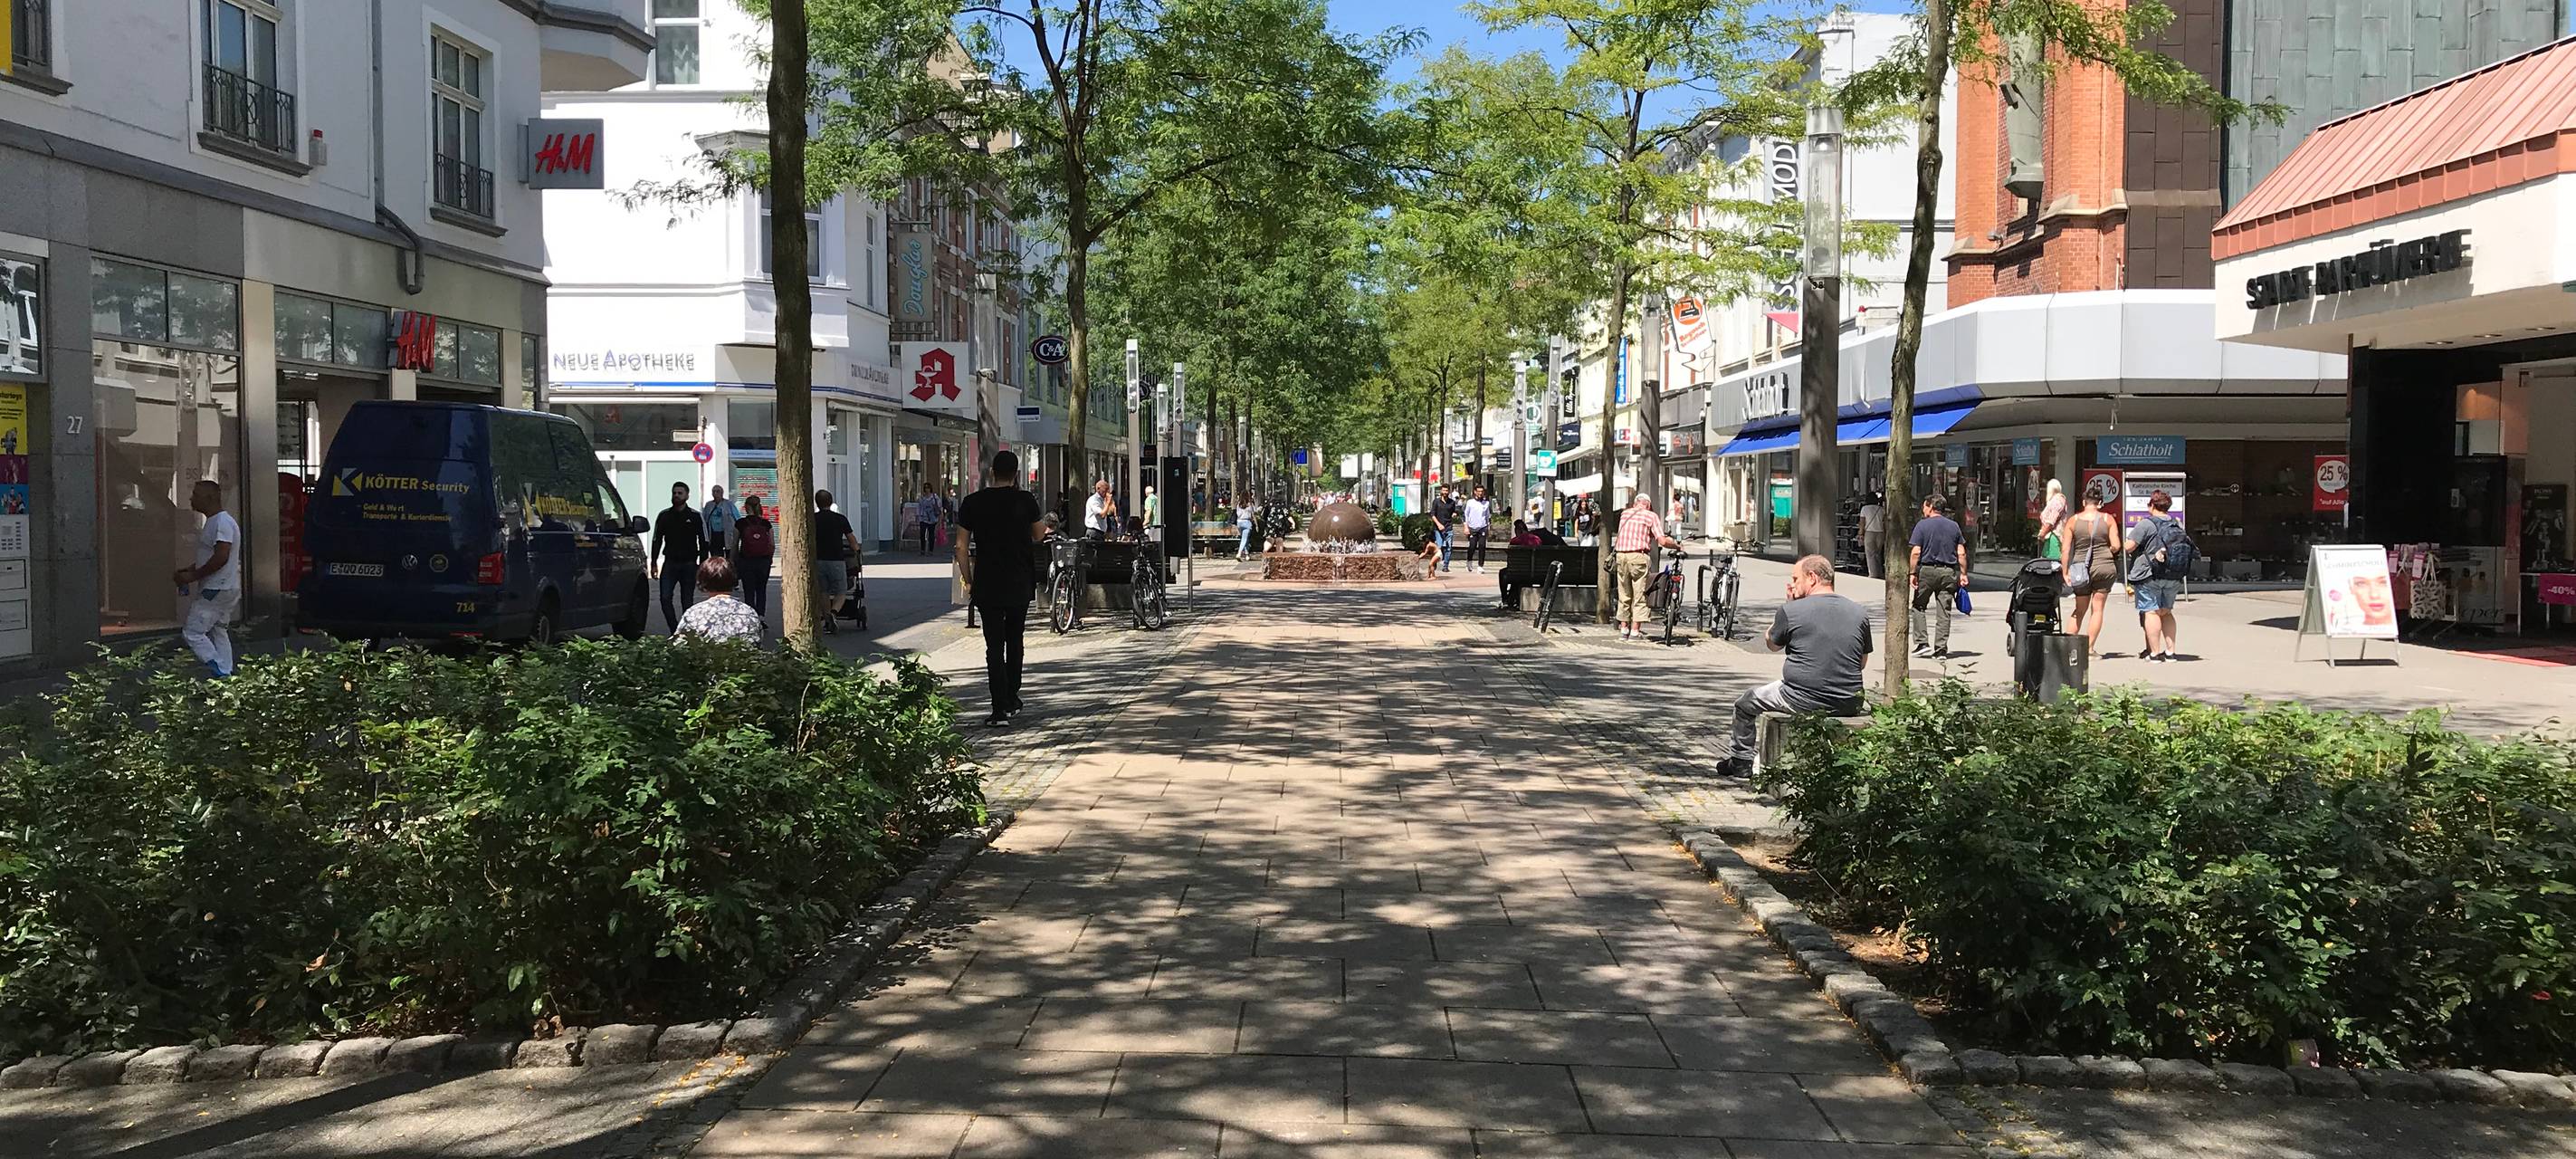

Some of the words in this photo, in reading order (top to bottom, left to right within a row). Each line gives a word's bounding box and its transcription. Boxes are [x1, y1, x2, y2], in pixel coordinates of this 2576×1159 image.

[535, 133, 595, 174] H&M
[902, 239, 928, 316] Douglas
[1813, 281, 1824, 290] 38
[396, 310, 435, 371] H&M
[1039, 342, 1065, 357] C&A
[553, 353, 599, 370] NEUE
[603, 350, 695, 371] APOTHEKE
[67, 416, 83, 434] 27
[2109, 442, 2174, 456] Schlatholt
[2321, 465, 2333, 481] 25
[2337, 465, 2349, 482] %
[366, 474, 418, 490] KÖTTER
[422, 481, 470, 494] Security
[2105, 479, 2118, 495] %
[2546, 586, 2576, 596] -40%
[457, 602, 475, 613] 714
